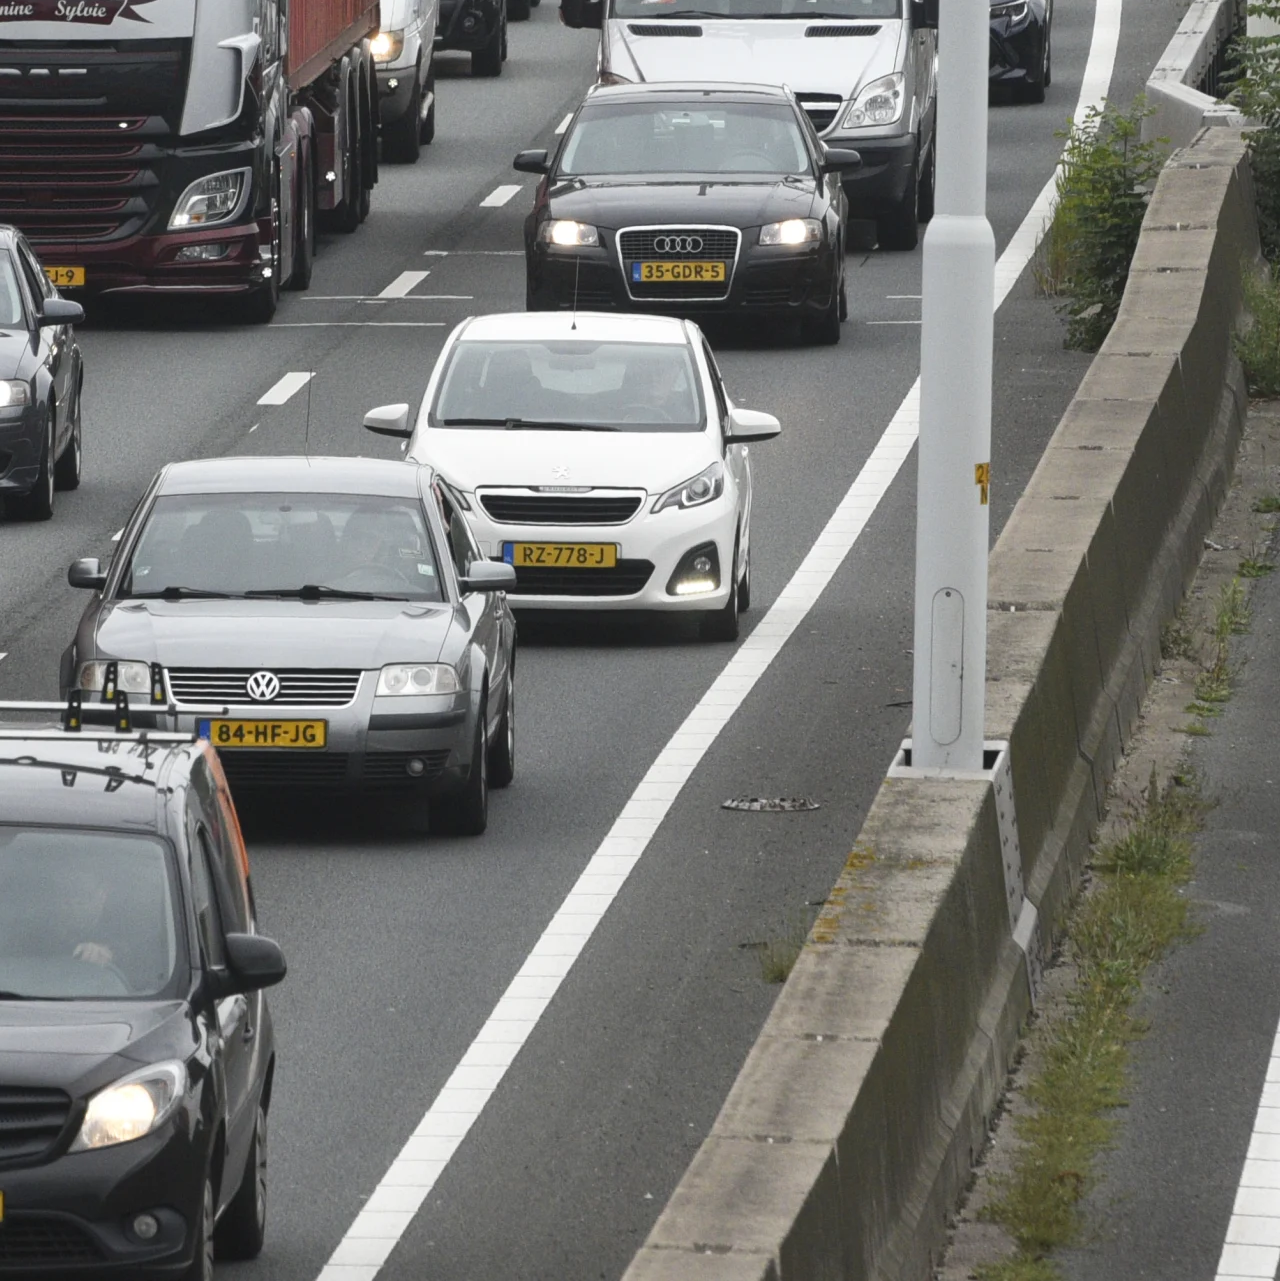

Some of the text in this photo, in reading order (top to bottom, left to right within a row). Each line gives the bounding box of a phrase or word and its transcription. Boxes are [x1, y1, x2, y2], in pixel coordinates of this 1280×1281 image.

[54, 0, 107, 20] Sylvie
[645, 264, 720, 279] 35-GDR-5
[523, 546, 604, 564] RZ-778-J
[218, 724, 316, 743] 84-HF-JG
